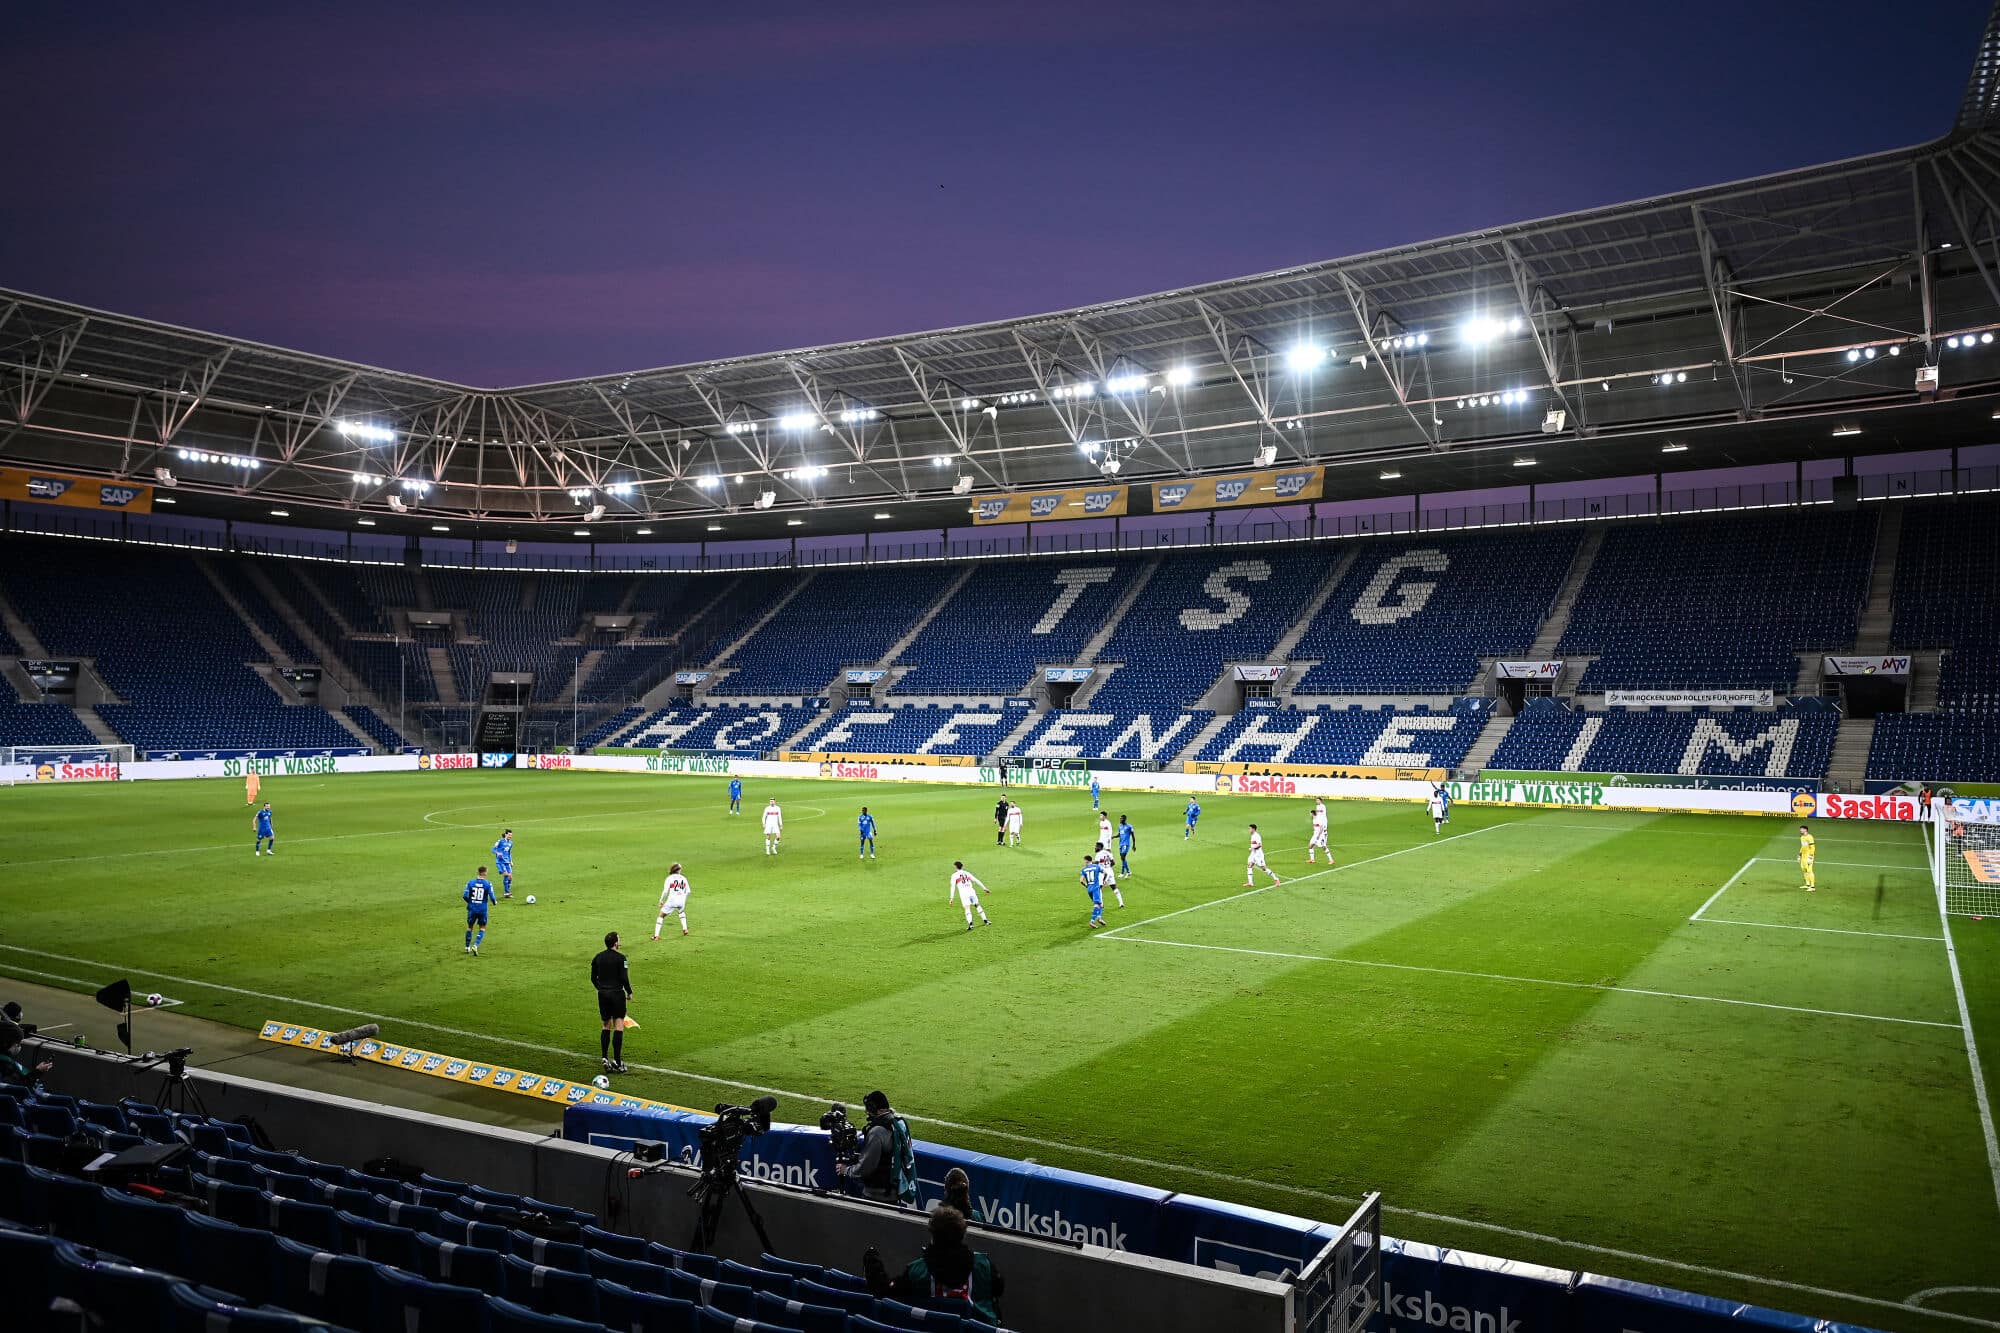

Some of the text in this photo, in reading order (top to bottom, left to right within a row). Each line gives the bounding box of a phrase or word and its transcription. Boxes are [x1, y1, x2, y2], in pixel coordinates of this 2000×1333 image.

[30, 480, 134, 504] SAP SAP
[1159, 476, 1305, 503] SAP SAP SAP
[1896, 480, 1906, 490] N
[979, 494, 1112, 517] SAP SAP SAP
[1590, 503, 1600, 513] M
[1362, 521, 1368, 530] L
[1161, 534, 1168, 542] K
[1047, 671, 1087, 680] SAP SAP
[1621, 694, 1635, 702] WIR
[1636, 694, 1665, 702] ROCKEN
[1666, 694, 1682, 702] UND
[1683, 694, 1711, 702] ROLLEN
[223, 756, 339, 776] SO GEHT WASSER.
[435, 754, 473, 769] Saskia
[482, 754, 508, 768] SAP
[540, 754, 571, 768] Saskia
[646, 757, 658, 771] SO
[1033, 758, 1061, 769] pre
[62, 763, 119, 780] Saskia
[837, 763, 878, 779] Saskia
[979, 768, 995, 783] SO
[1008, 768, 1032, 785] EHT
[1238, 774, 1296, 794] Saskia
[1469, 782, 1516, 802] GEHT
[1826, 794, 1914, 821] Saskia
[673, 879, 684, 892] 24
[263, 1025, 278, 1036] SAP
[284, 1028, 297, 1039] SAP
[303, 1031, 317, 1043] SAP
[361, 1041, 378, 1054] SAP
[384, 1047, 399, 1058] SAP
[404, 1052, 419, 1063] SAP
[424, 1057, 441, 1068] SAP
[446, 1062, 463, 1073] SAP
[471, 1068, 487, 1079] SAP
[494, 1072, 512, 1083] SAP
[518, 1077, 535, 1089] SAP
[543, 1082, 560, 1094] SAP
[568, 1088, 585, 1100] SAP
[593, 1094, 611, 1105] SAP
[979, 1195, 1128, 1251] Volksbank
